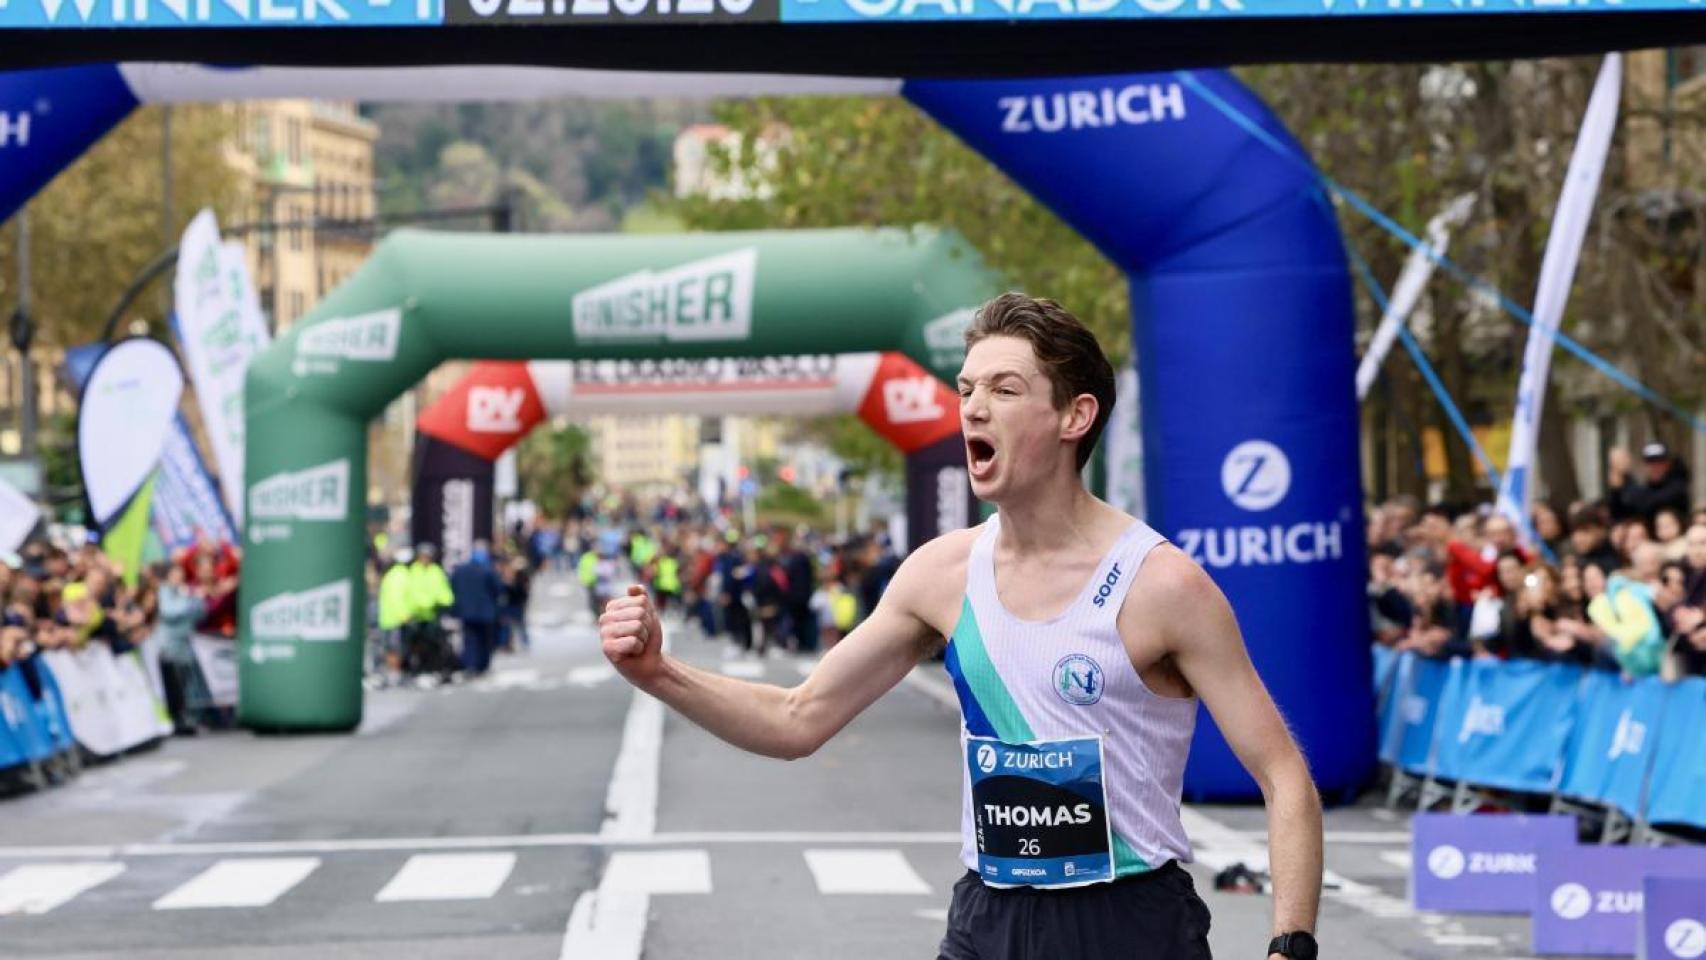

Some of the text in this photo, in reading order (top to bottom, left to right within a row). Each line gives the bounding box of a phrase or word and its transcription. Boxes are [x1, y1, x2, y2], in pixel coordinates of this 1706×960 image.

[998, 84, 1186, 132] ZURICH
[1176, 520, 1343, 568] ZURICH
[1093, 562, 1122, 608] soar
[1004, 751, 1073, 769] ZURICH
[984, 804, 1092, 827] THOMAS
[1018, 838, 1041, 856] 26
